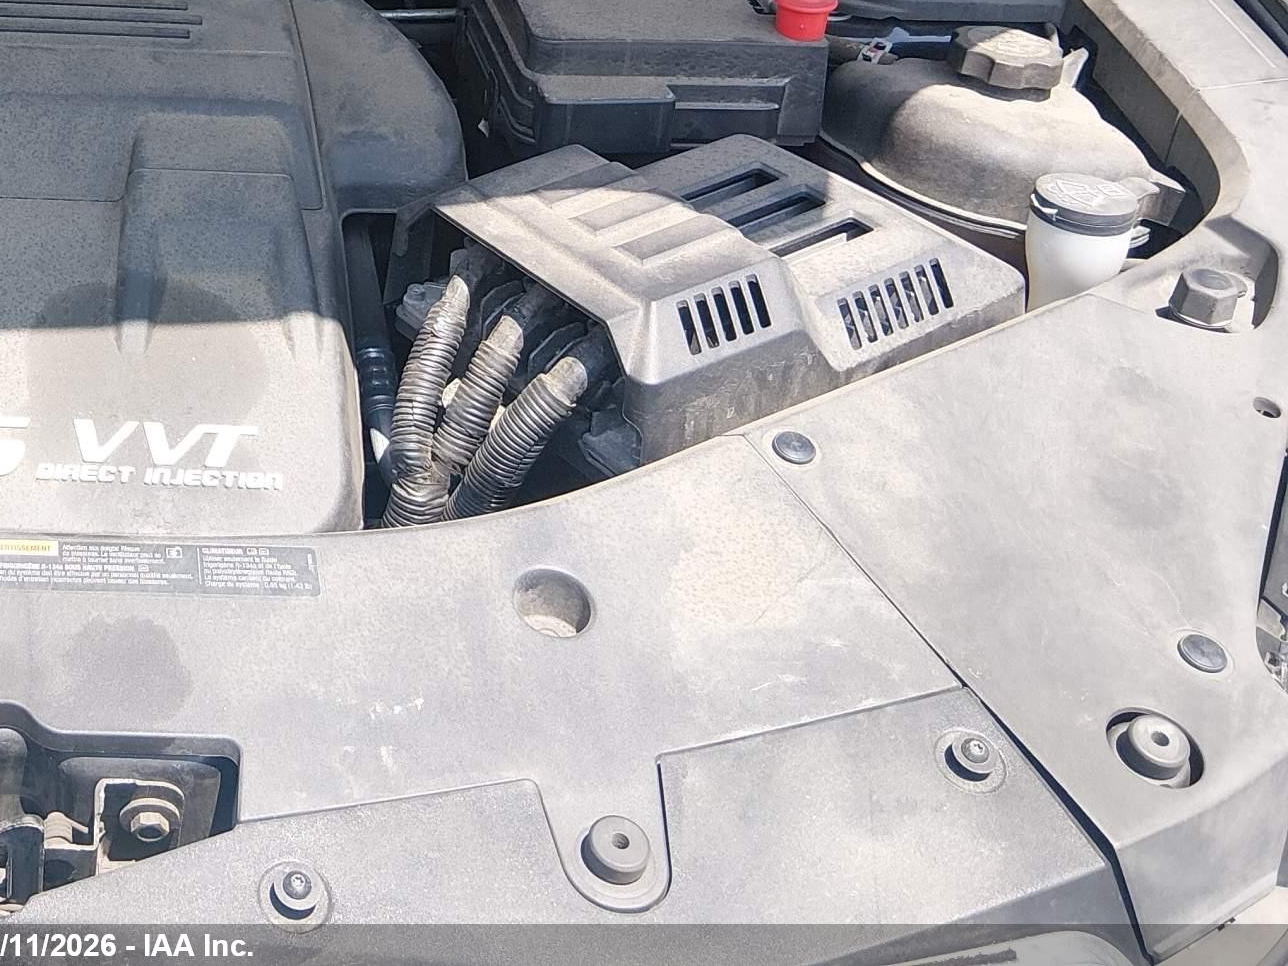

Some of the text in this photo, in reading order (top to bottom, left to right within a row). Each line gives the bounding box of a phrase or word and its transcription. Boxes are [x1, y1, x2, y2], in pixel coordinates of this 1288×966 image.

[73, 418, 259, 468] VVT
[35, 463, 284, 490] DIRECT INJECTION
